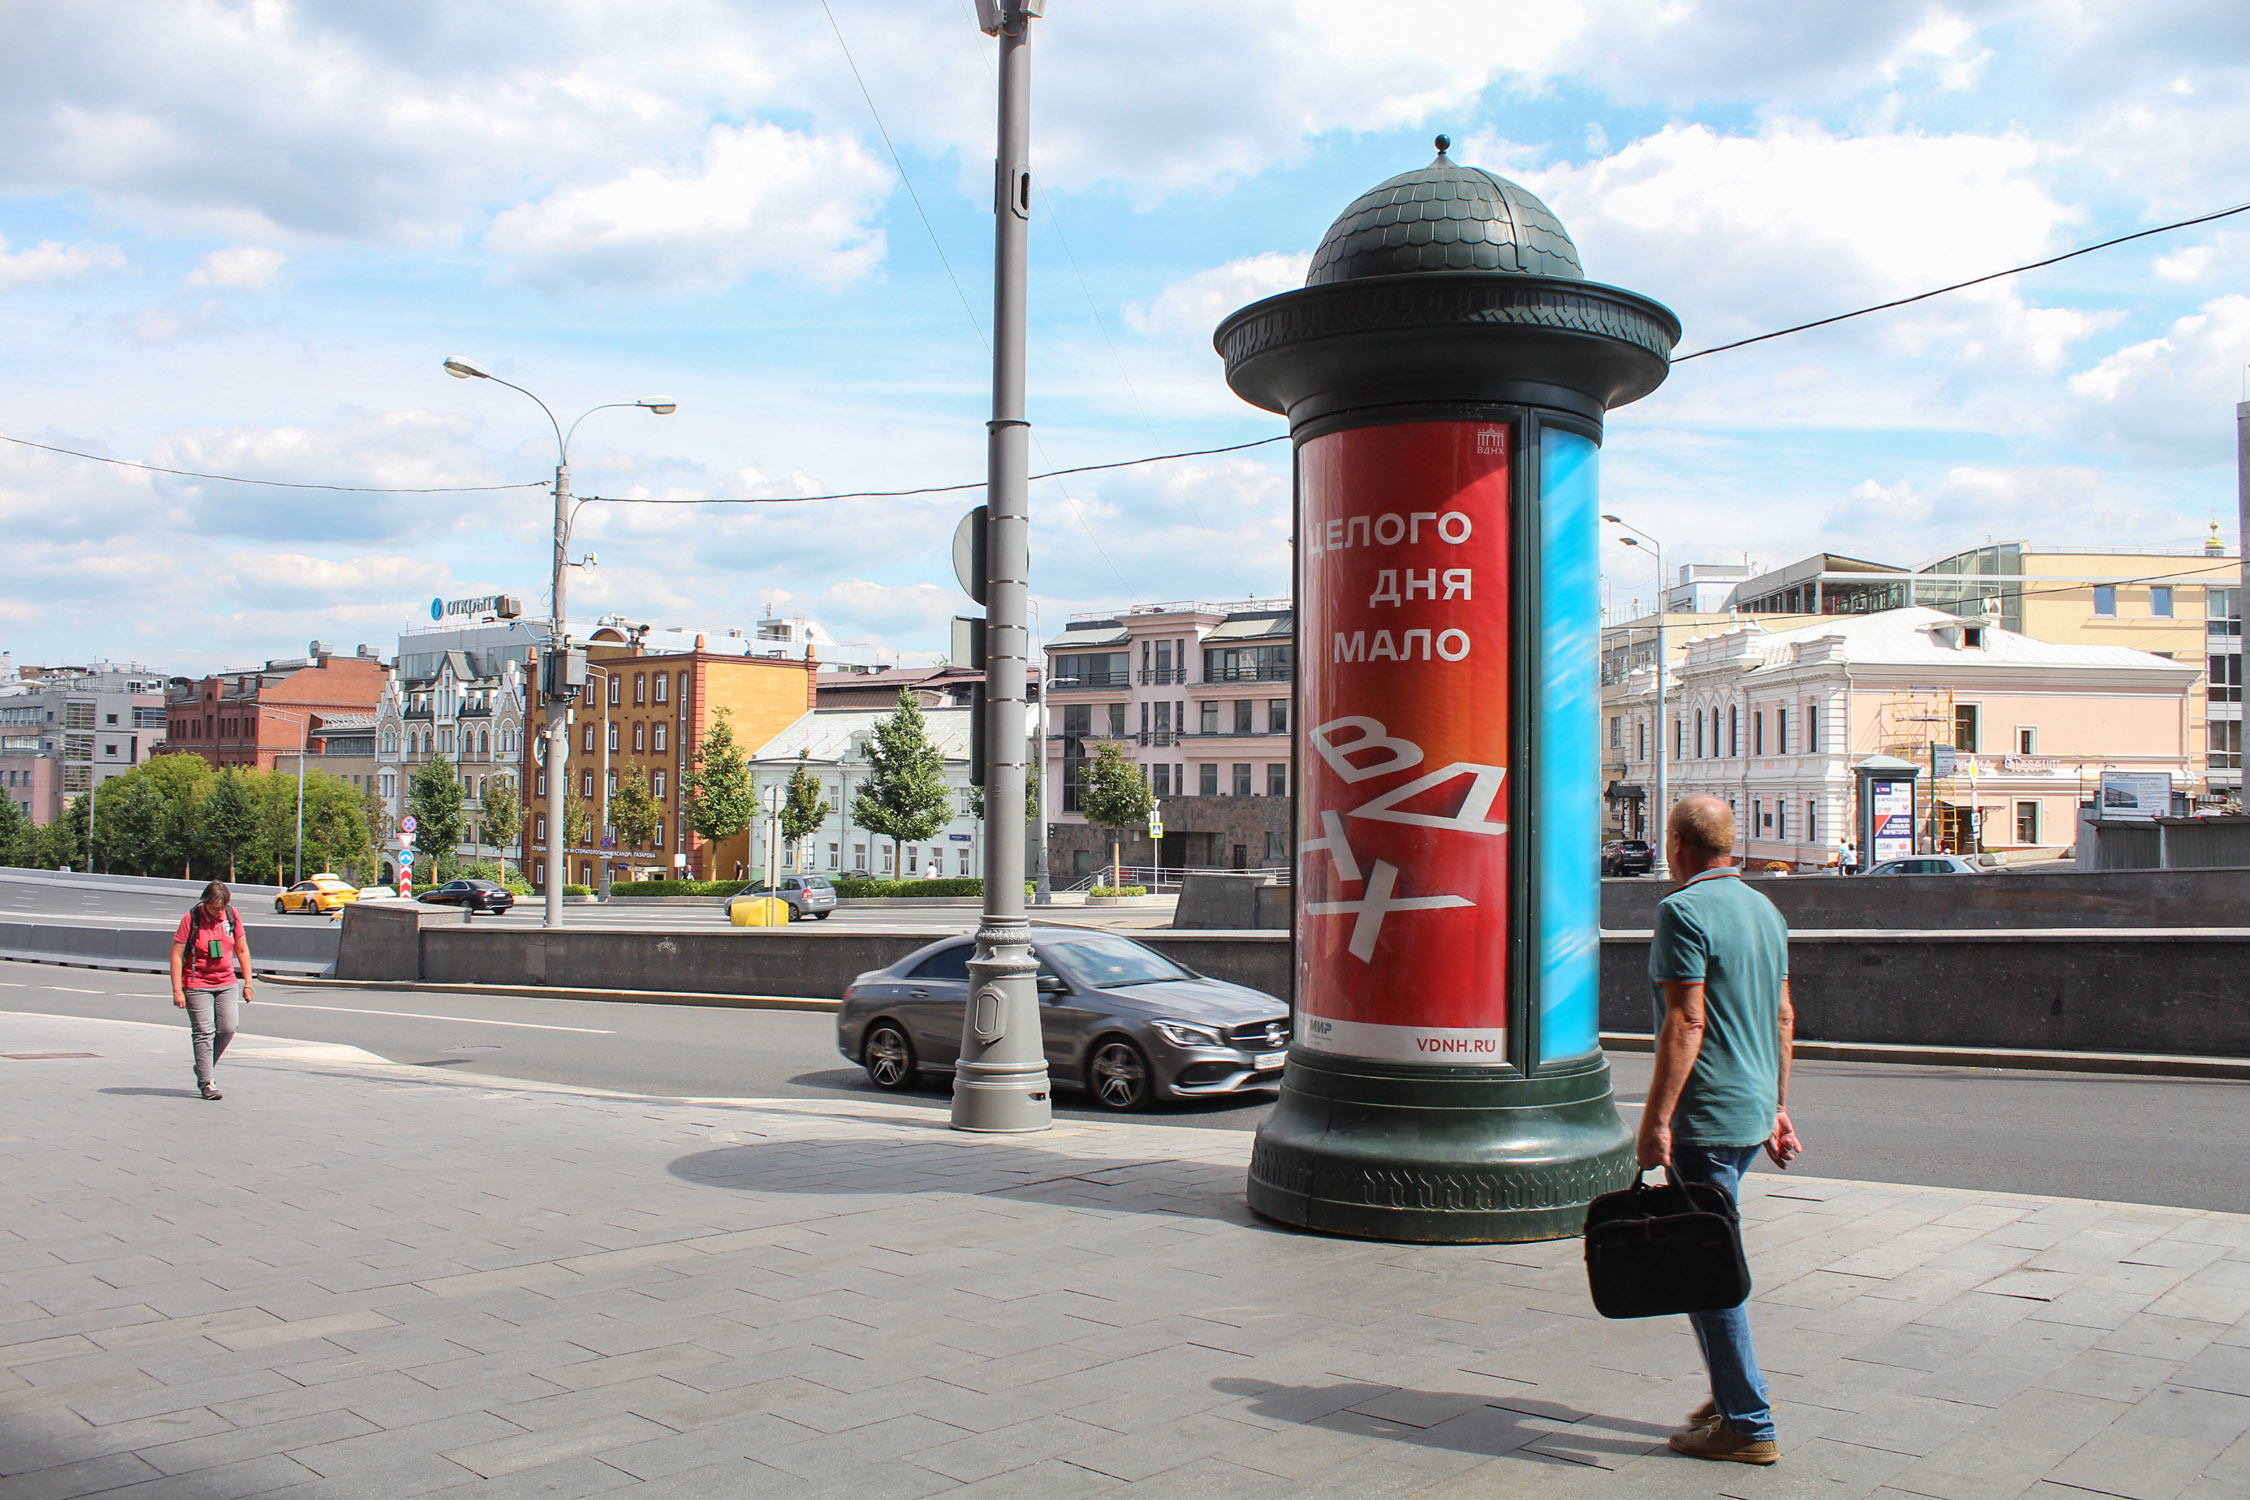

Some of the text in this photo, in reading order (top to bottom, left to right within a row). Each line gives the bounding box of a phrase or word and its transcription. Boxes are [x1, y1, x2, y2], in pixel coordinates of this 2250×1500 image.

[1477, 446, 1504, 455] ВДНХ
[1308, 511, 1472, 559] ЦЕЛОГО
[1369, 568, 1472, 608] ДНЯ
[447, 596, 496, 619] открыт
[1334, 628, 1471, 663] МАЛО
[1310, 1019, 1332, 1034] МИР
[1416, 1038, 1496, 1053] VDNH.RU
